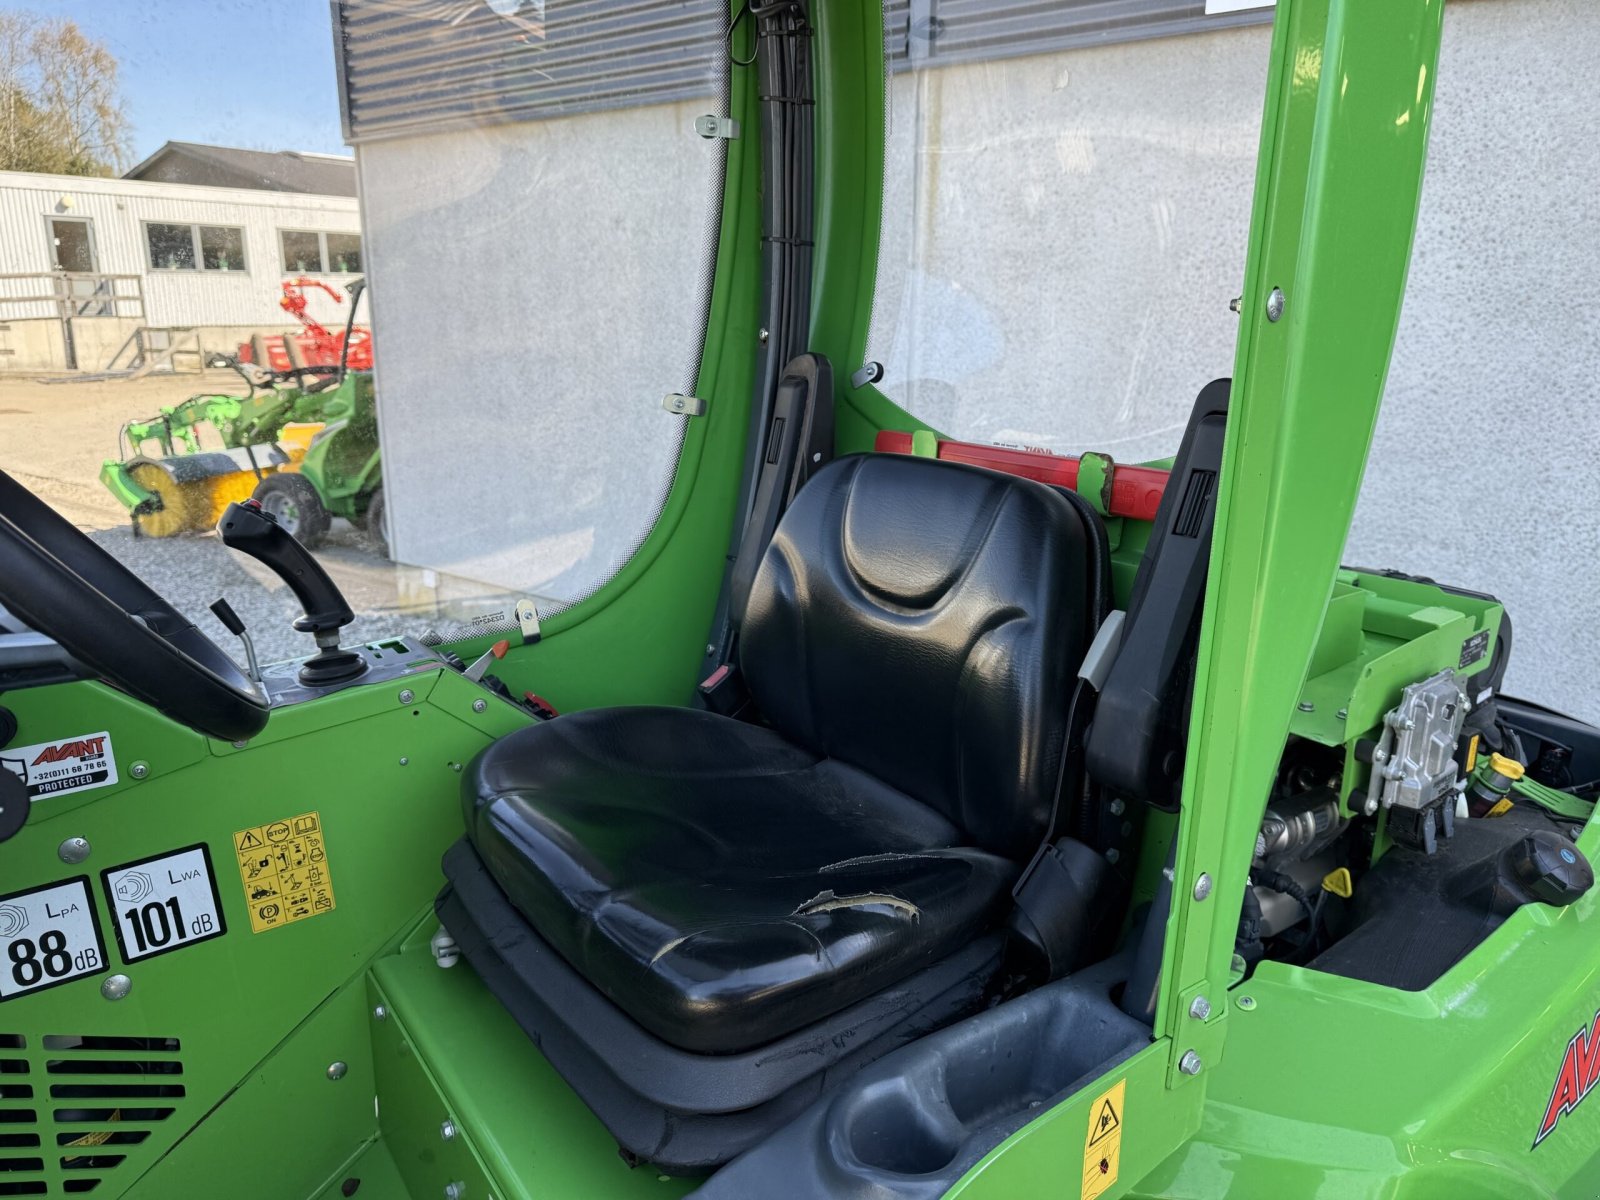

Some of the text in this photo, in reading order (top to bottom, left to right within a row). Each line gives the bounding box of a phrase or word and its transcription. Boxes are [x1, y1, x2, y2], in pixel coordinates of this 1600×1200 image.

[30, 736, 105, 766] AVANT
[33, 760, 107, 780] +32(0)11 68 78 65
[38, 774, 93, 793] PROTECTED
[268, 827, 289, 838] STOP
[124, 895, 213, 953] 101 dB
[7, 929, 98, 987] 88 dB
